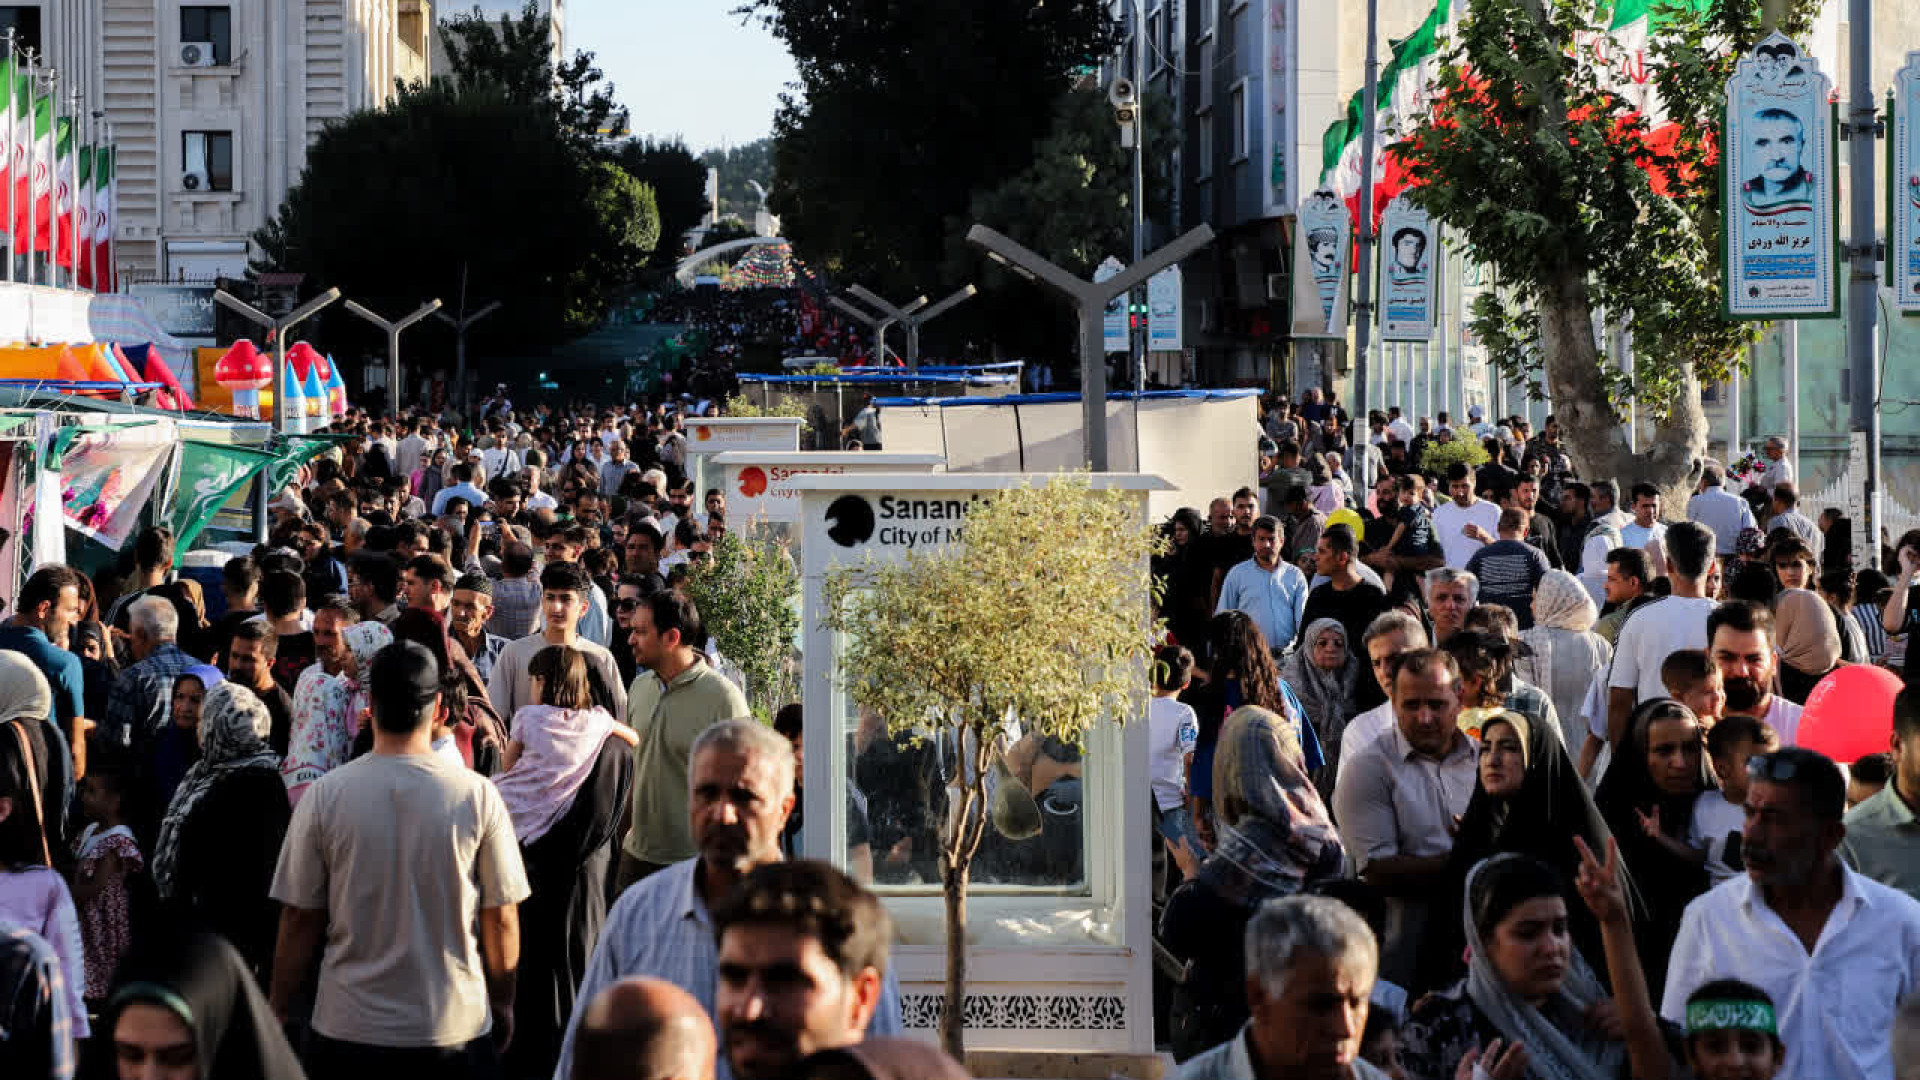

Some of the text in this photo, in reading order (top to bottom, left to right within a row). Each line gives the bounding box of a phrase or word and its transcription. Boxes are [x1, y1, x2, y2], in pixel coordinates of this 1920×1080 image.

[1776, 233, 1789, 246] الله
[880, 494, 988, 519] Sanan
[880, 526, 917, 548] City
[921, 526, 941, 544] of
